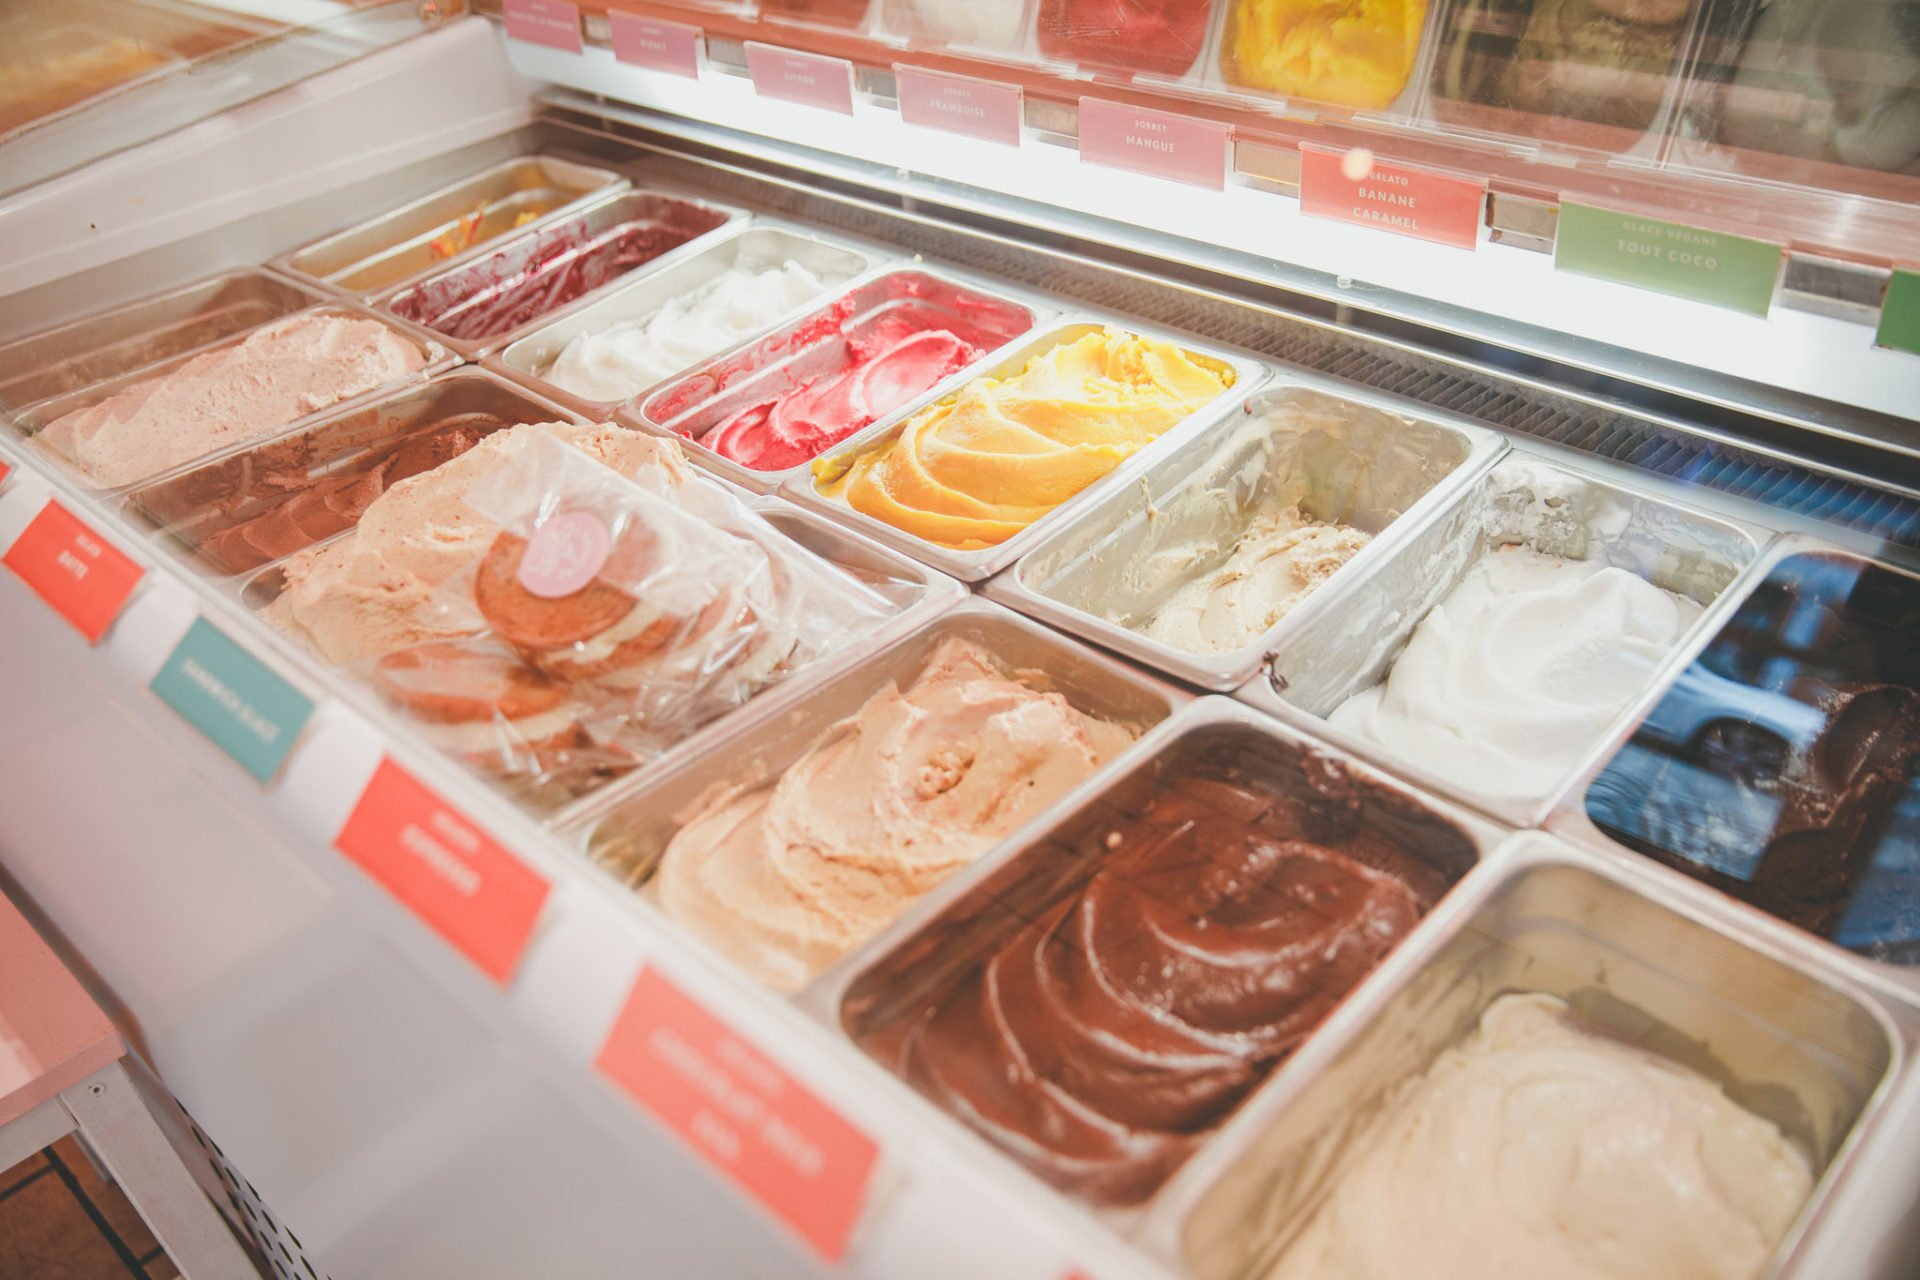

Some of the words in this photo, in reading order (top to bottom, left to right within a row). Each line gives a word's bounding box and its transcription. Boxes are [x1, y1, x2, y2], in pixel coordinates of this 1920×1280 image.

[929, 101, 985, 118] FRAMBOISE
[1134, 119, 1167, 133] SORBET
[1126, 134, 1176, 153] MANGUE
[1369, 171, 1409, 186] GELATO
[1358, 187, 1416, 208] BANANE
[1353, 207, 1419, 230] CARAMEL
[1618, 239, 1661, 257] TOUT
[1668, 250, 1718, 270] COCO
